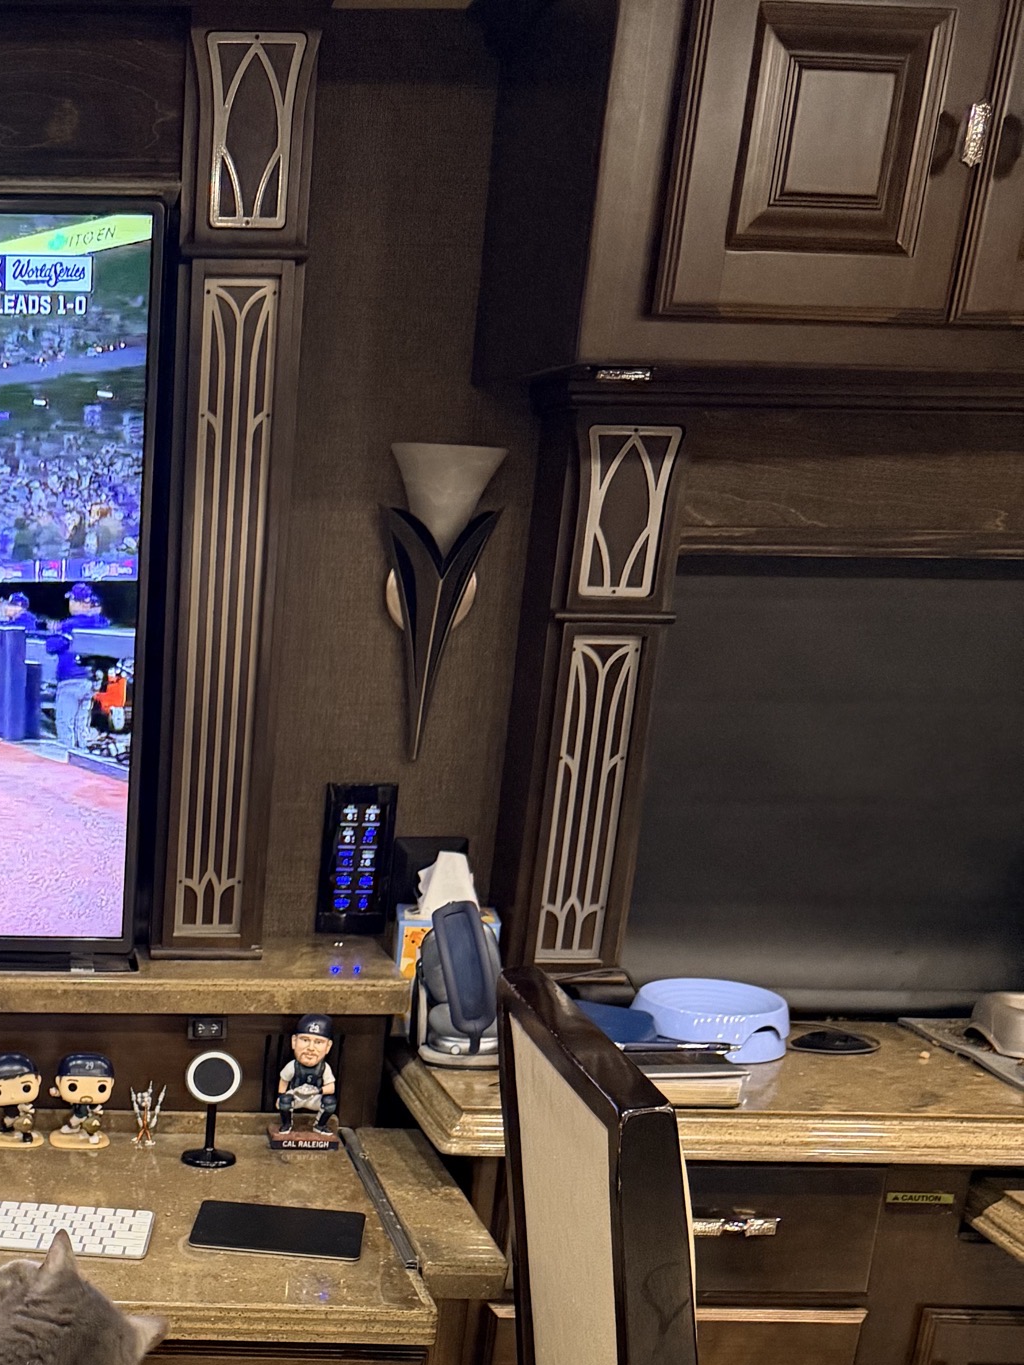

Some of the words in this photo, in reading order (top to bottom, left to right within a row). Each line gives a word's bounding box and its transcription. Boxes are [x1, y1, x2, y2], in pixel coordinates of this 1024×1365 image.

[12, 259, 52, 279] World
[47, 262, 86, 287] Series
[57, 295, 87, 315] 1-0
[85, 1061, 95, 1070] 29
[282, 1140, 296, 1148] CAL
[298, 1140, 330, 1149] RALEIGH
[901, 1194, 942, 1202] CAUTION
